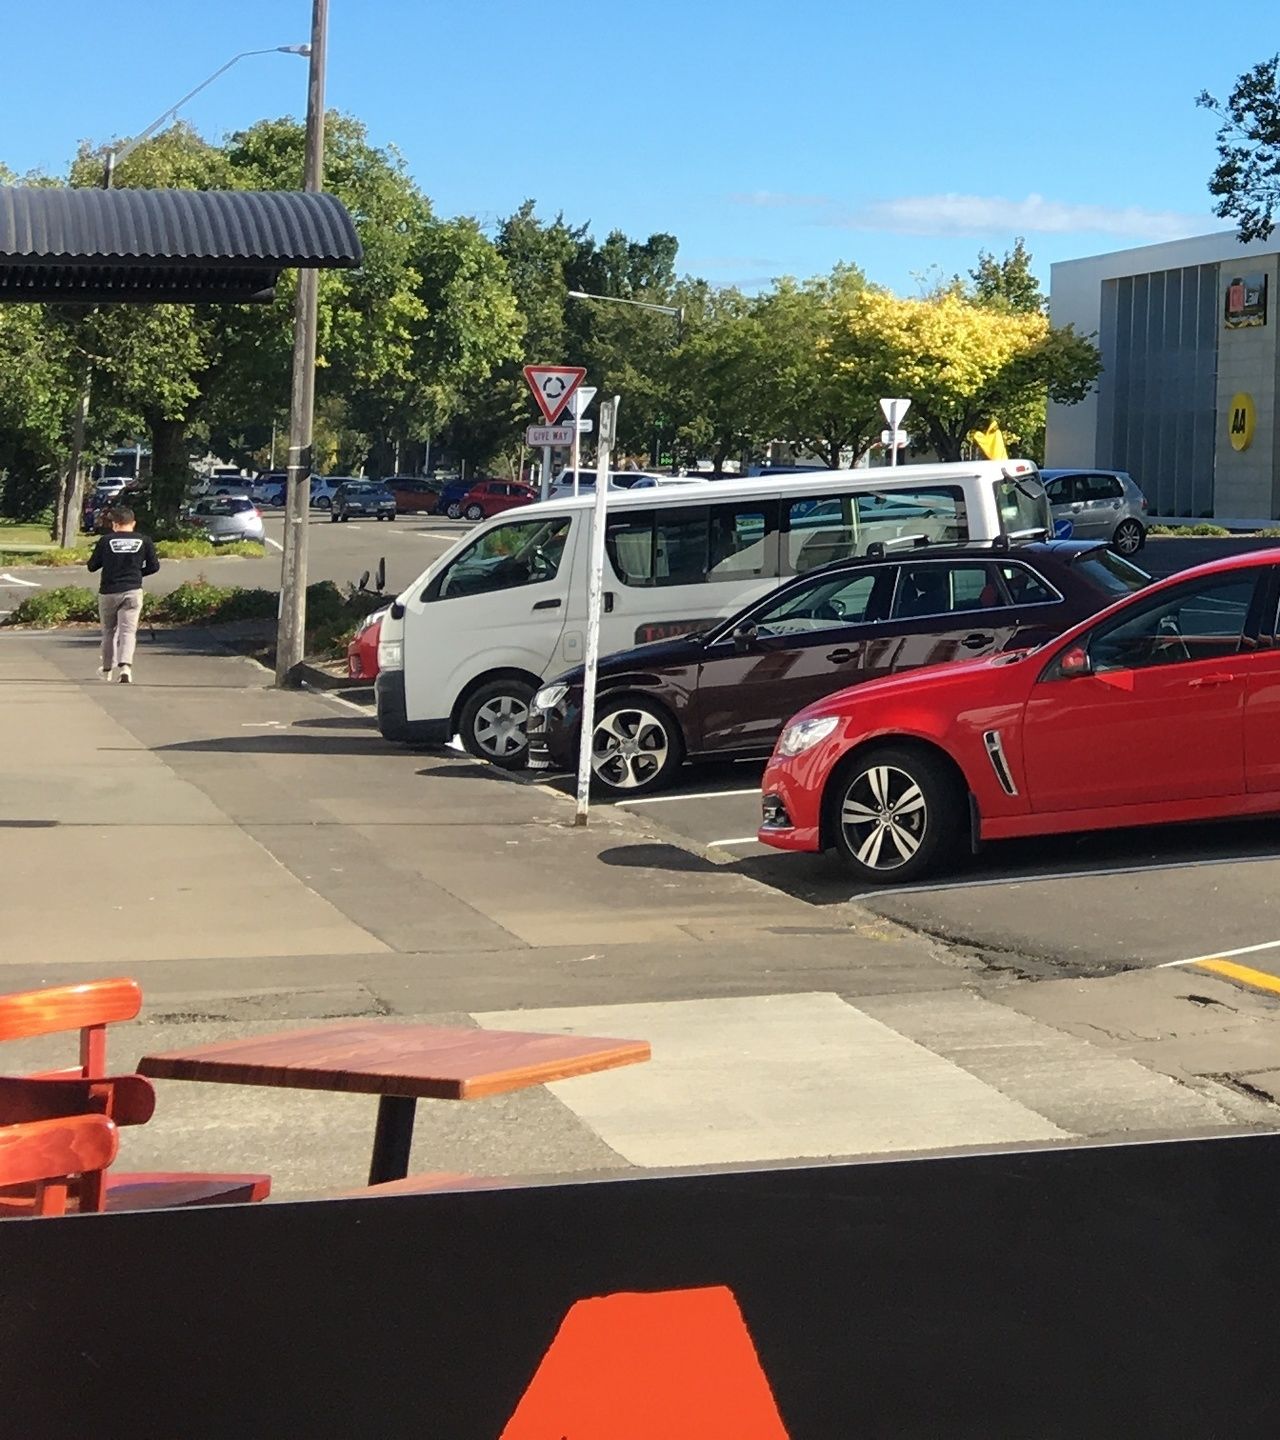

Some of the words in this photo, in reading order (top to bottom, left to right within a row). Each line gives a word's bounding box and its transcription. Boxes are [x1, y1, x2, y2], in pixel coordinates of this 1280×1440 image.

[1231, 408, 1246, 434] AA
[533, 431, 549, 441] GIVE
[553, 431, 568, 441] WAY
